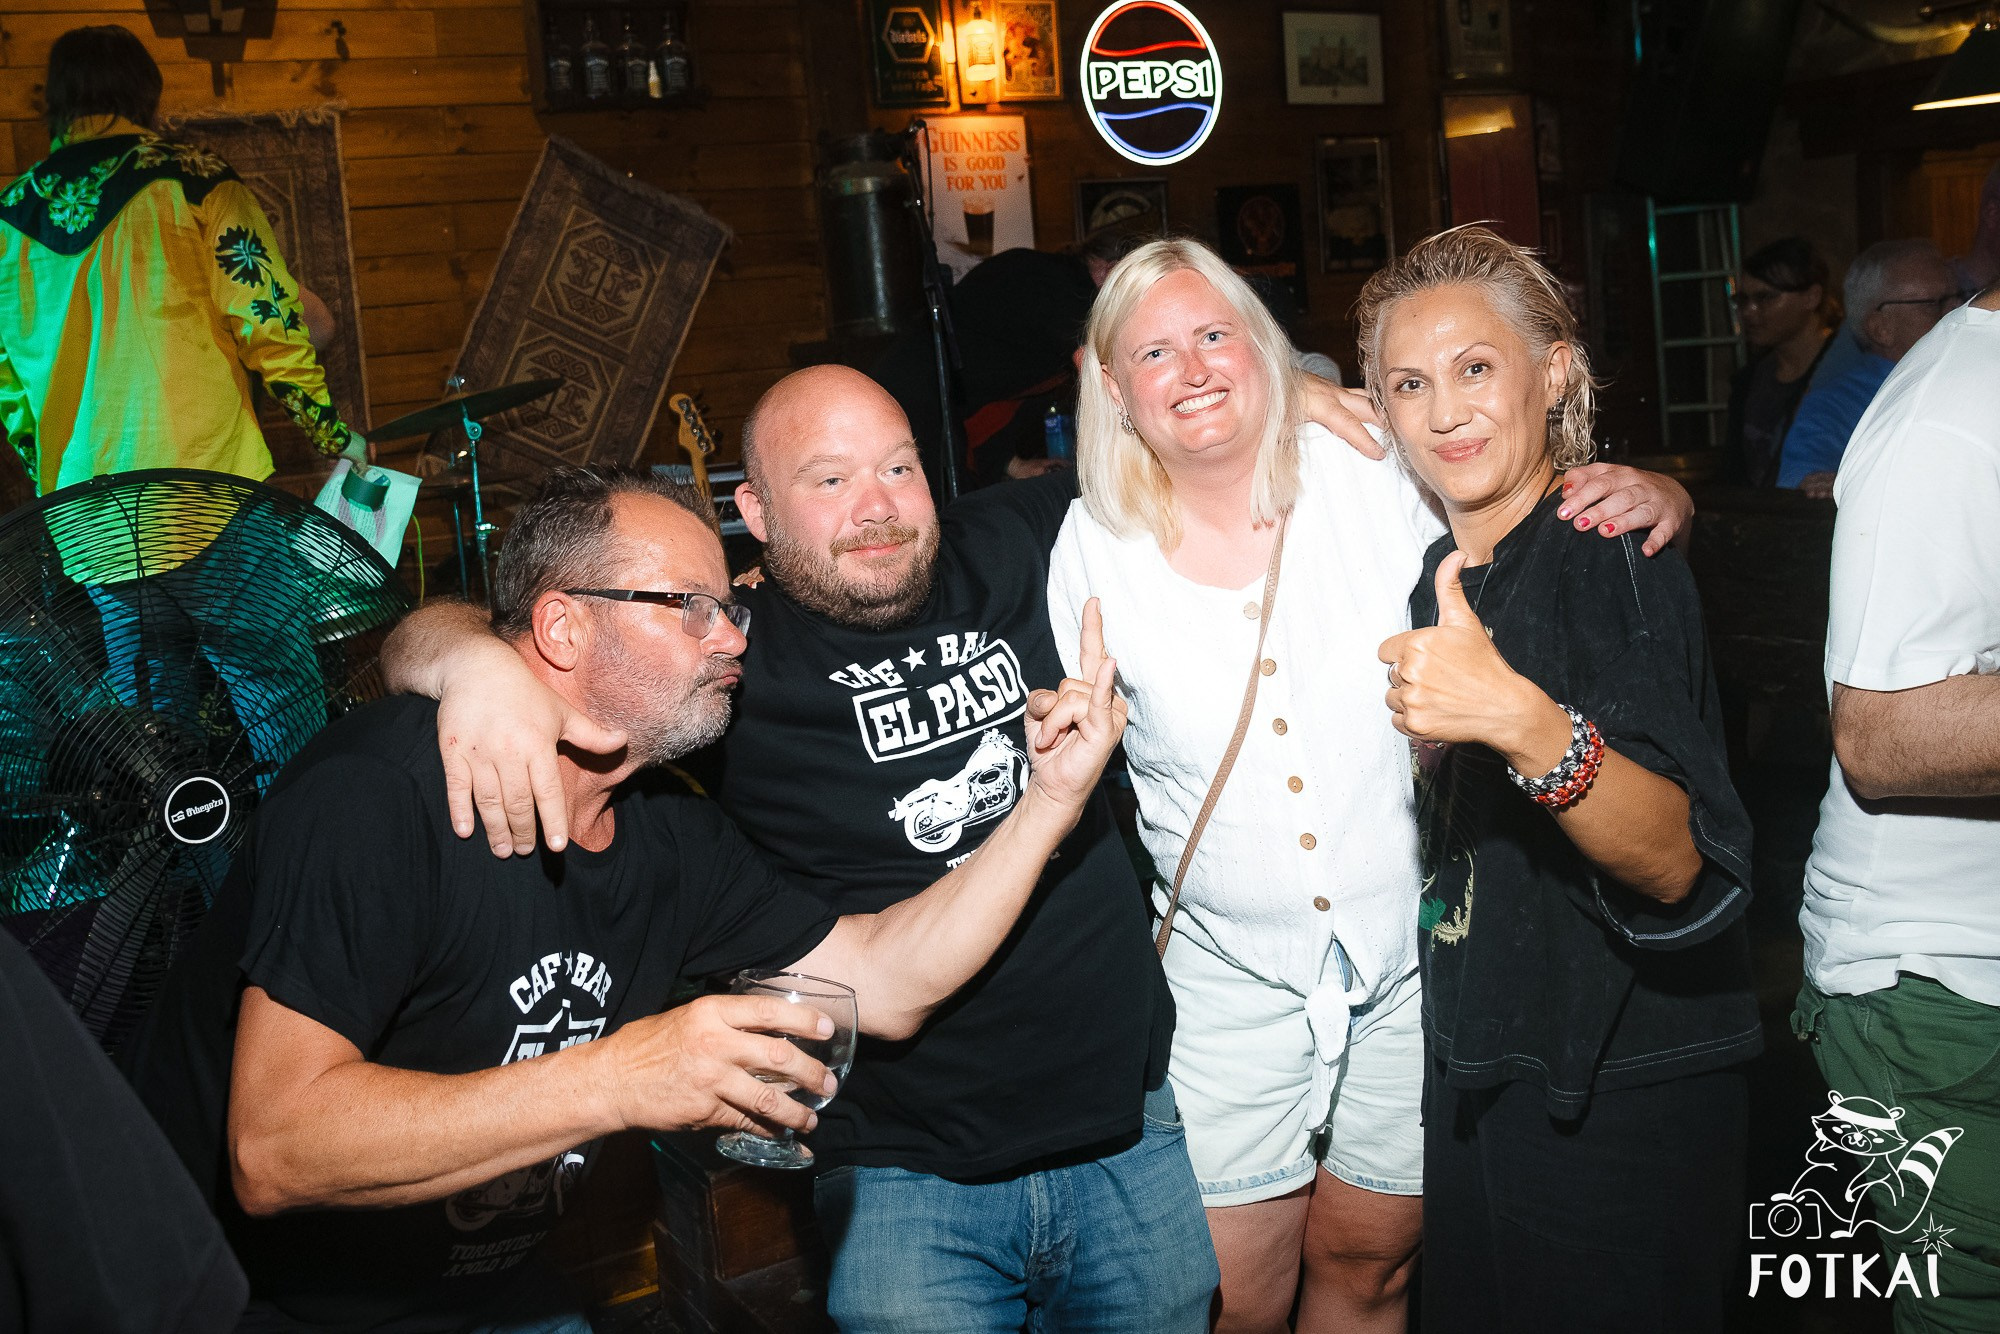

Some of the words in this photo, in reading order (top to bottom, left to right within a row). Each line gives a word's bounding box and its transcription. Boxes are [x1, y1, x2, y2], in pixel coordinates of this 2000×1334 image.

[1090, 59, 1215, 100] PEPSI
[923, 127, 1021, 153] GUINNESS
[944, 156, 957, 171] IS
[966, 156, 1006, 171] GOOD
[946, 176, 974, 191] FOR
[979, 175, 1008, 190] YOU
[868, 697, 931, 752] EL
[927, 652, 1022, 736] PASO
[571, 951, 613, 1009] BAR
[441, 1257, 501, 1277] APOLO
